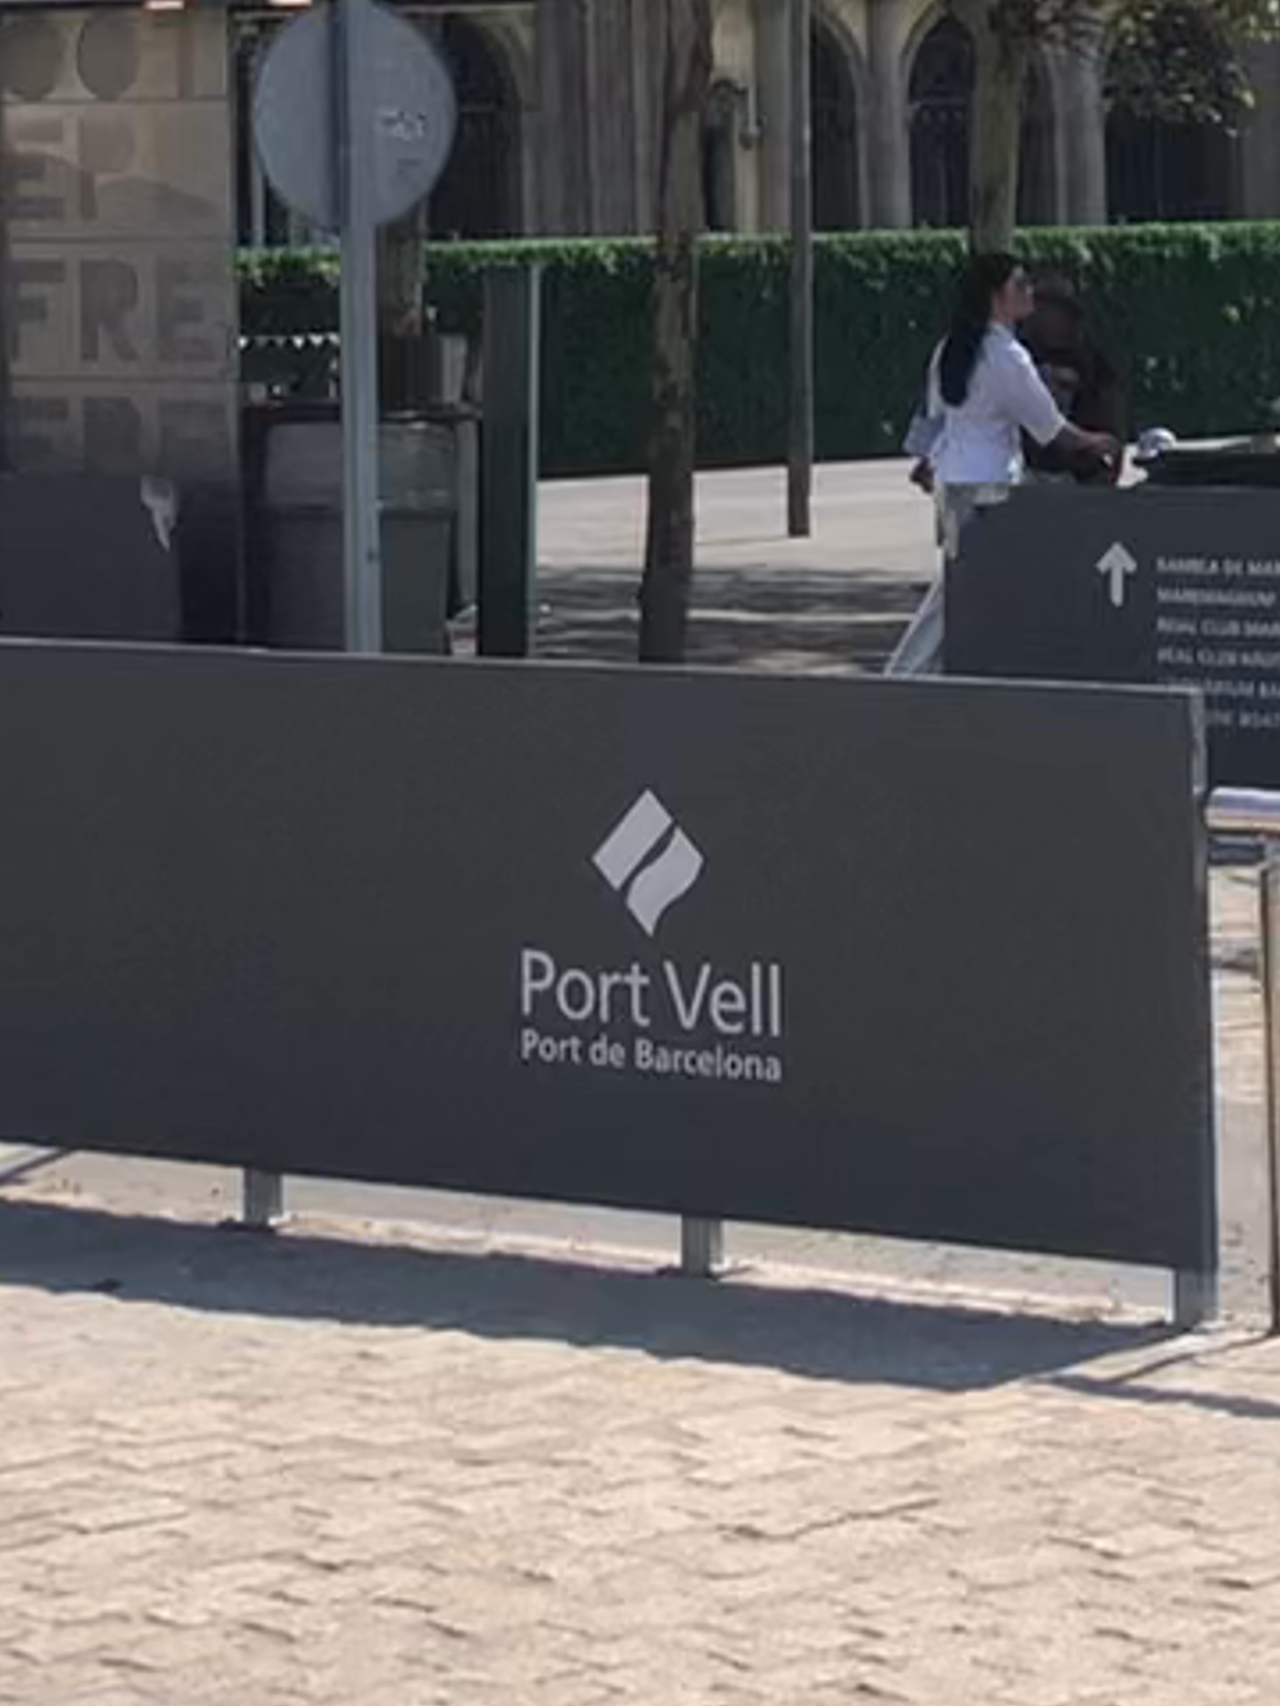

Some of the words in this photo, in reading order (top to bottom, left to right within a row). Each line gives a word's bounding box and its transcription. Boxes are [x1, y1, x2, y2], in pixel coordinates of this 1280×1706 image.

[522, 948, 650, 1026] Port
[664, 959, 781, 1037] Vell
[522, 1028, 581, 1063] Port
[589, 1033, 625, 1068] de
[635, 1037, 782, 1083] Barcelona
